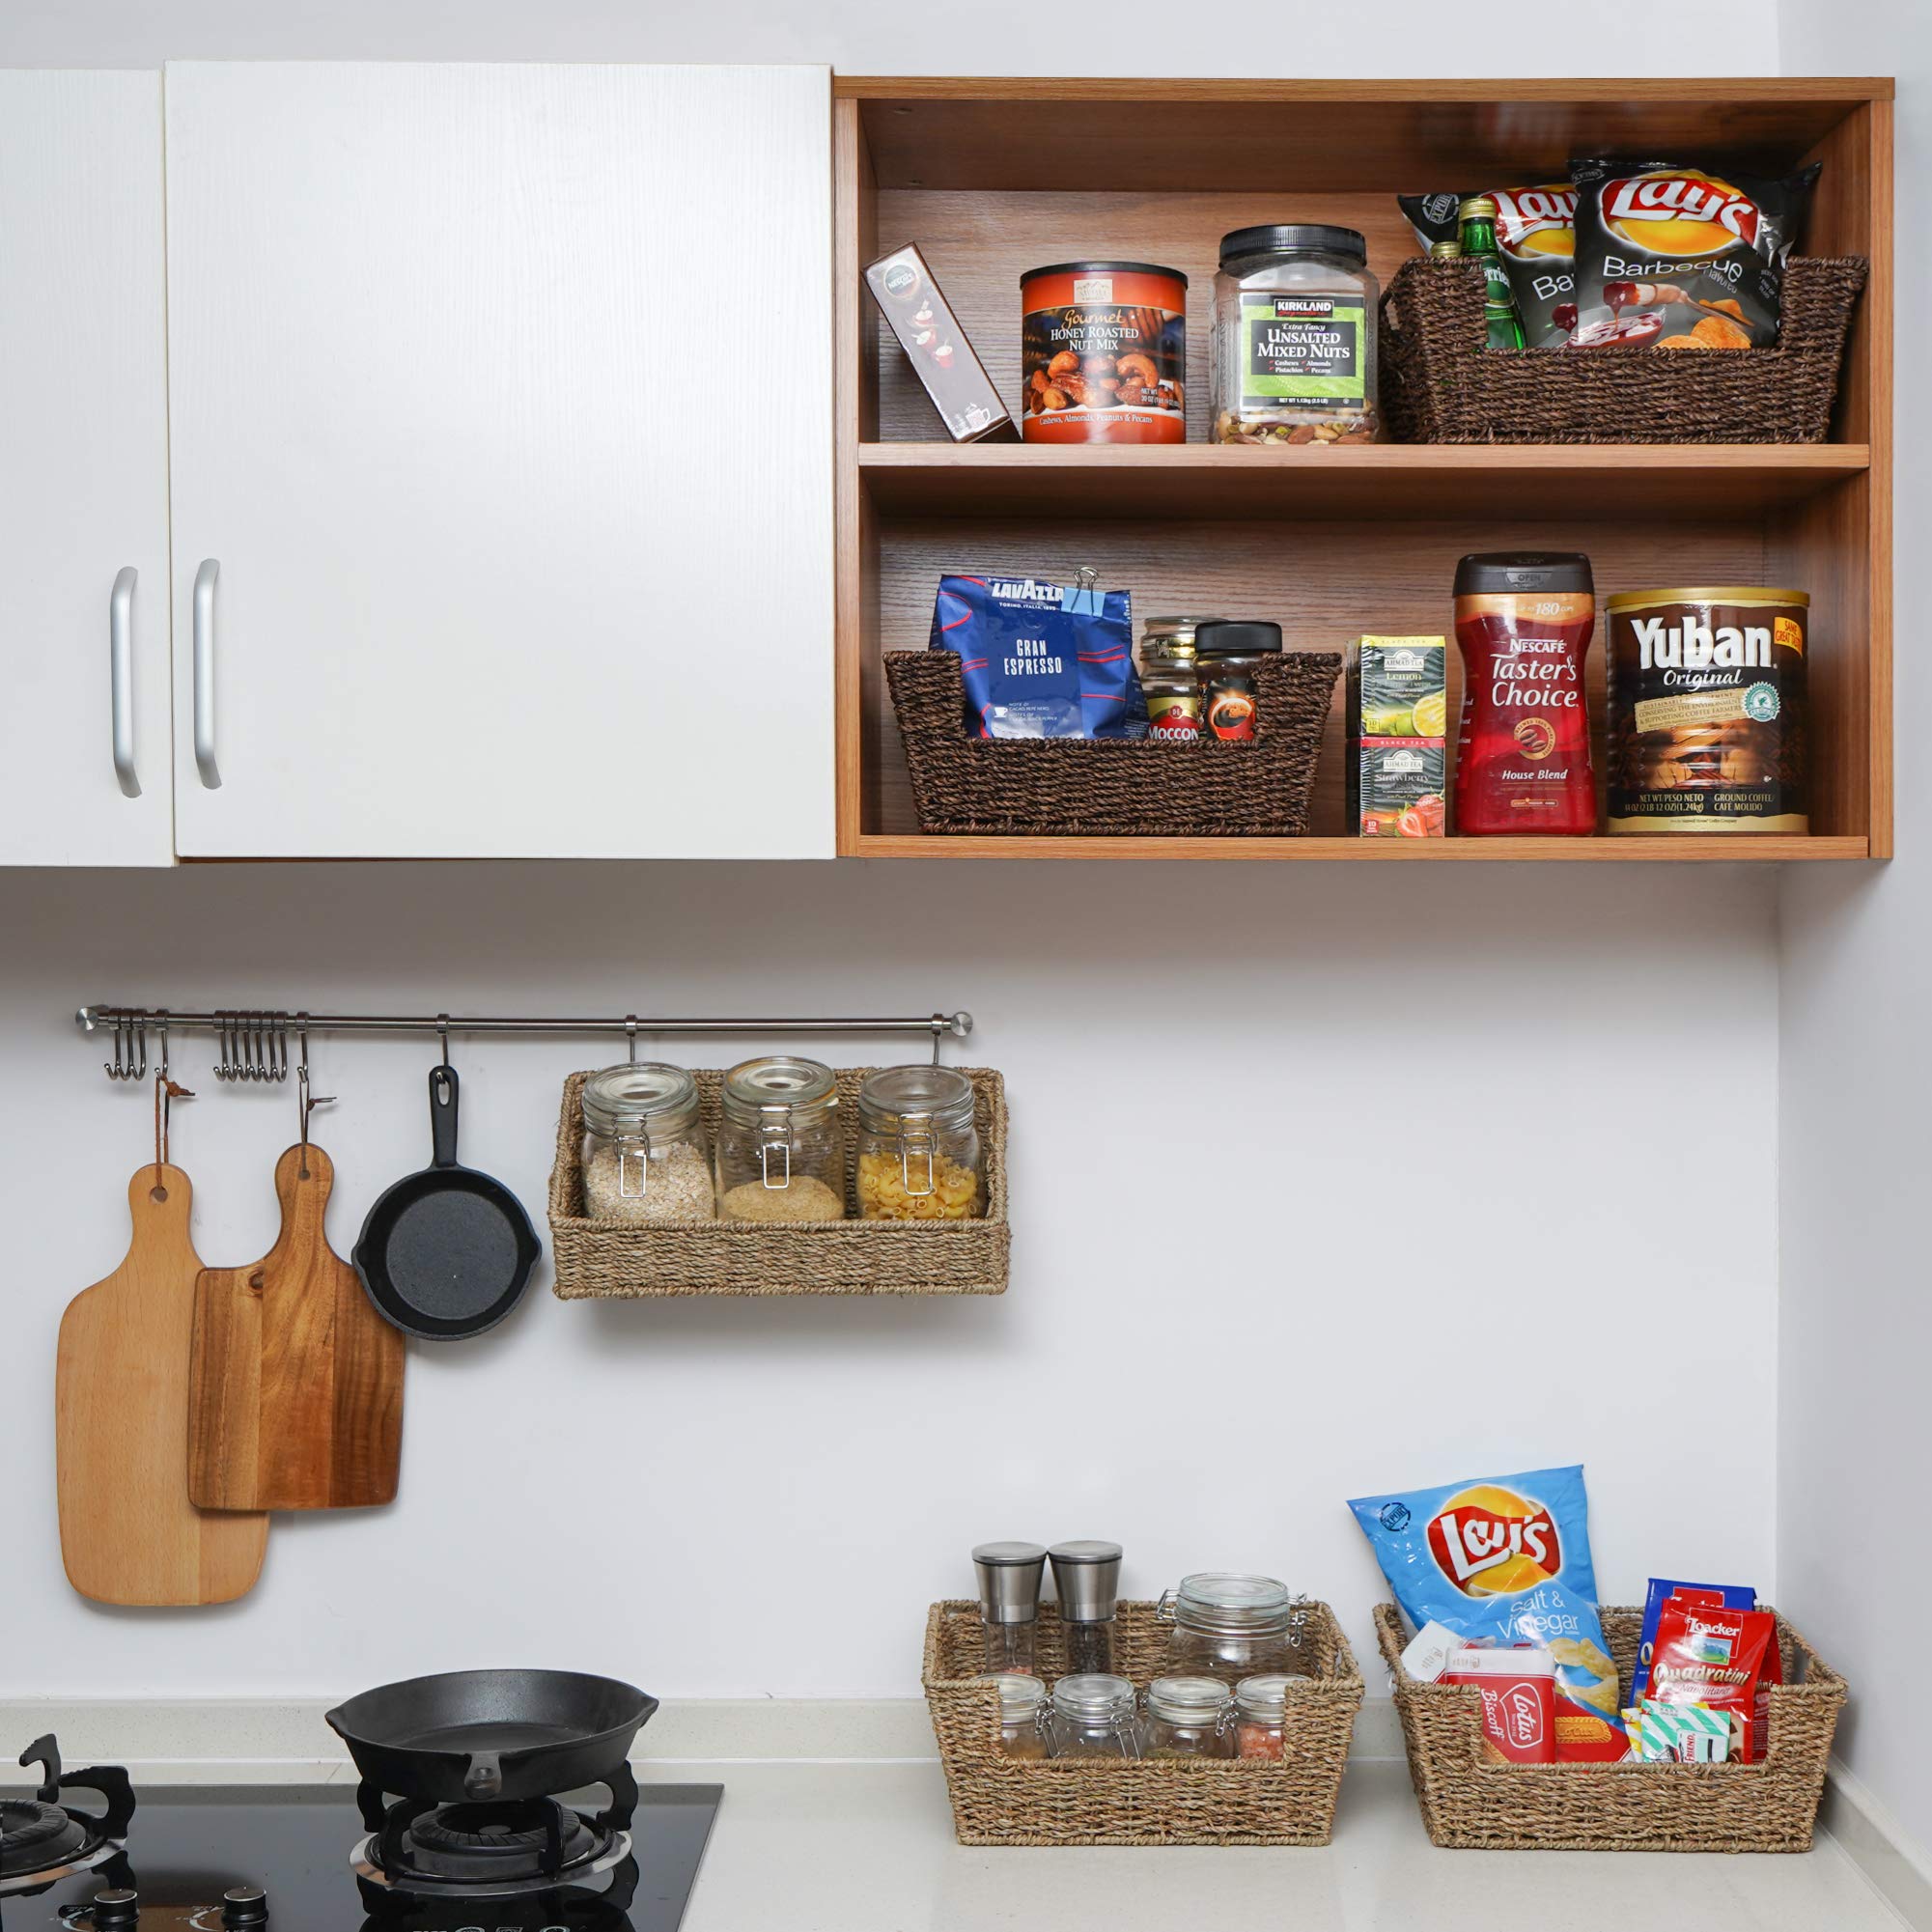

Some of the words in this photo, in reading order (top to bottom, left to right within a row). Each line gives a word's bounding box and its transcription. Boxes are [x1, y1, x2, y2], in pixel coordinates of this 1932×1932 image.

[1610, 180, 1752, 237] Lay's
[1603, 255, 1743, 283] Barbecue
[1277, 301, 1331, 311] KIRKLAND
[1061, 309, 1126, 330] Gourmet
[1304, 323, 1326, 332] Fancy
[1050, 328, 1085, 341] HONEY
[1088, 326, 1139, 339] ROASTED
[1268, 328, 1341, 344] UNSALTED
[1069, 339, 1093, 351] NUT
[1097, 338, 1118, 350] MIX
[1257, 343, 1306, 357] MIXED
[1309, 344, 1350, 358] NUTS
[1096, 413, 1123, 422] Peanuts
[992, 579, 1064, 602] LAVAZZA
[1536, 602, 1560, 616] 180
[1017, 639, 1047, 657] GRAN
[1509, 639, 1567, 654] NESCAFÉ
[1630, 616, 1773, 669] Yuban
[1003, 658, 1063, 676] ESPRESSO
[1490, 655, 1577, 682] Taster's
[1386, 672, 1422, 681] Lemon
[1663, 669, 1744, 692] Original
[1492, 682, 1579, 707] Choice
[1685, 709, 1710, 717] COFFEE
[1374, 773, 1429, 783] Strawberry
[1501, 770, 1535, 780] House
[1538, 769, 1568, 780] Blend
[1683, 793, 1704, 802] NETO
[1714, 794, 1747, 802] GROUND
[1734, 802, 1763, 811] MOLIDO
[1440, 1513, 1549, 1582] Lay's
[1552, 1590, 1565, 1609] &
[1497, 1614, 1579, 1639] Vinegar
[1685, 1616, 1741, 1637] Loacker
[1653, 1662, 1751, 1687] Quadratini
[1480, 1689, 1505, 1741] Biscoff
[1513, 1694, 1537, 1741] Lotus
